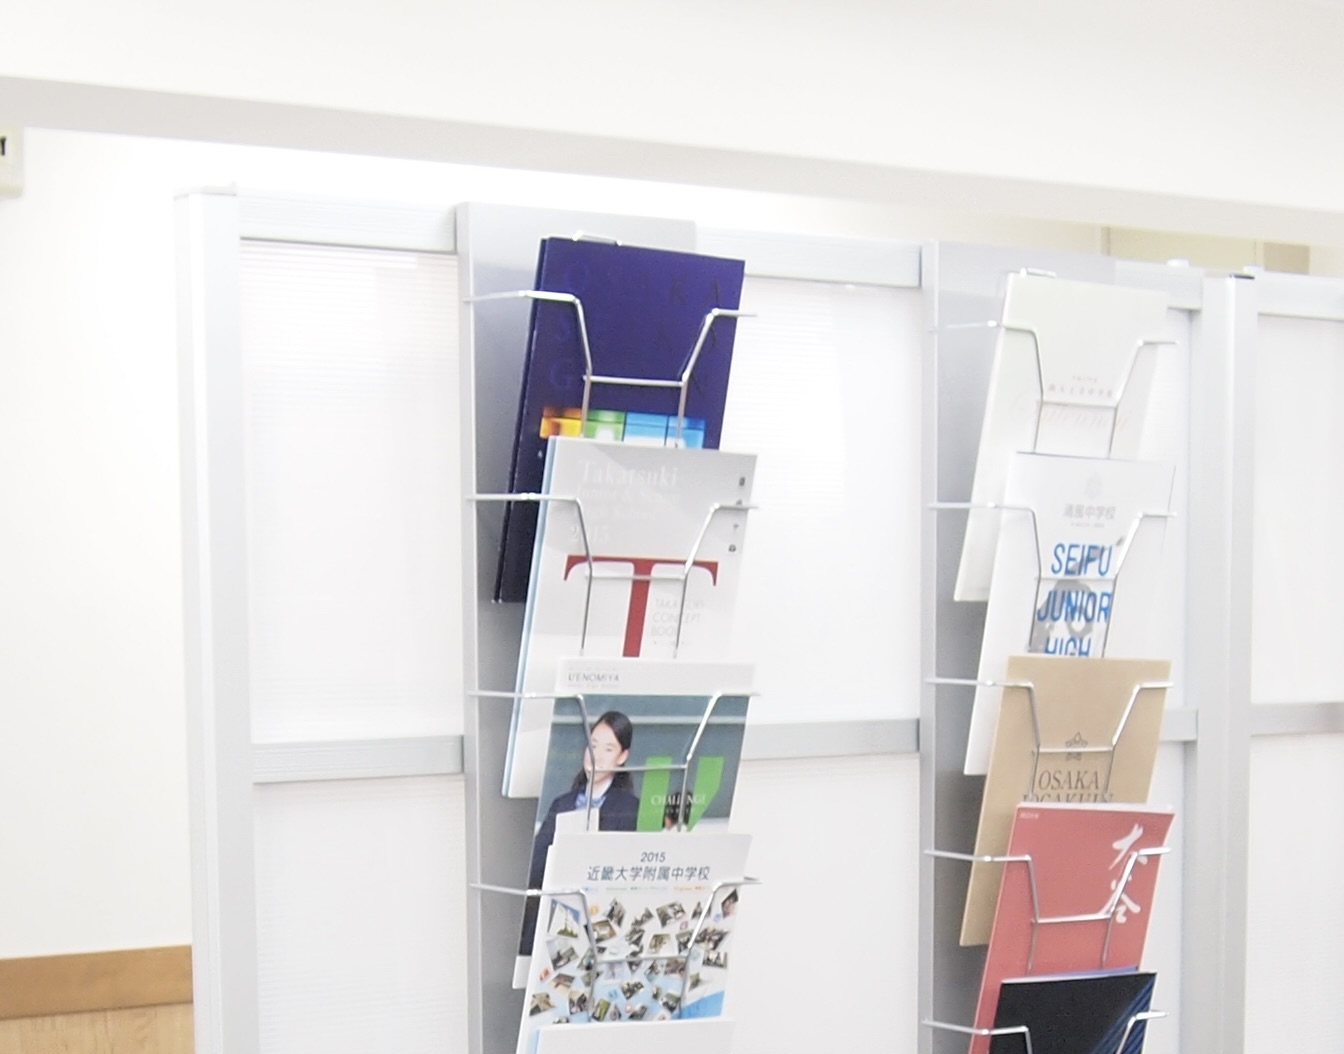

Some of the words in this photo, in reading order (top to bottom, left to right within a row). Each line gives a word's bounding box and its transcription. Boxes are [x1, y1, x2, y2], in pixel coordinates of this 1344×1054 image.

[569, 526, 609, 544] 215
[1051, 543, 1112, 576] SEIFU
[1037, 590, 1112, 623] JUNIOR
[653, 611, 701, 625] CONEPT
[568, 672, 619, 682] UENOMIYA
[1038, 770, 1099, 791] OSAKA
[650, 794, 706, 806] CHALLNGE
[640, 851, 666, 863] 2015
[587, 865, 711, 882] 近畿大学附属中学校
